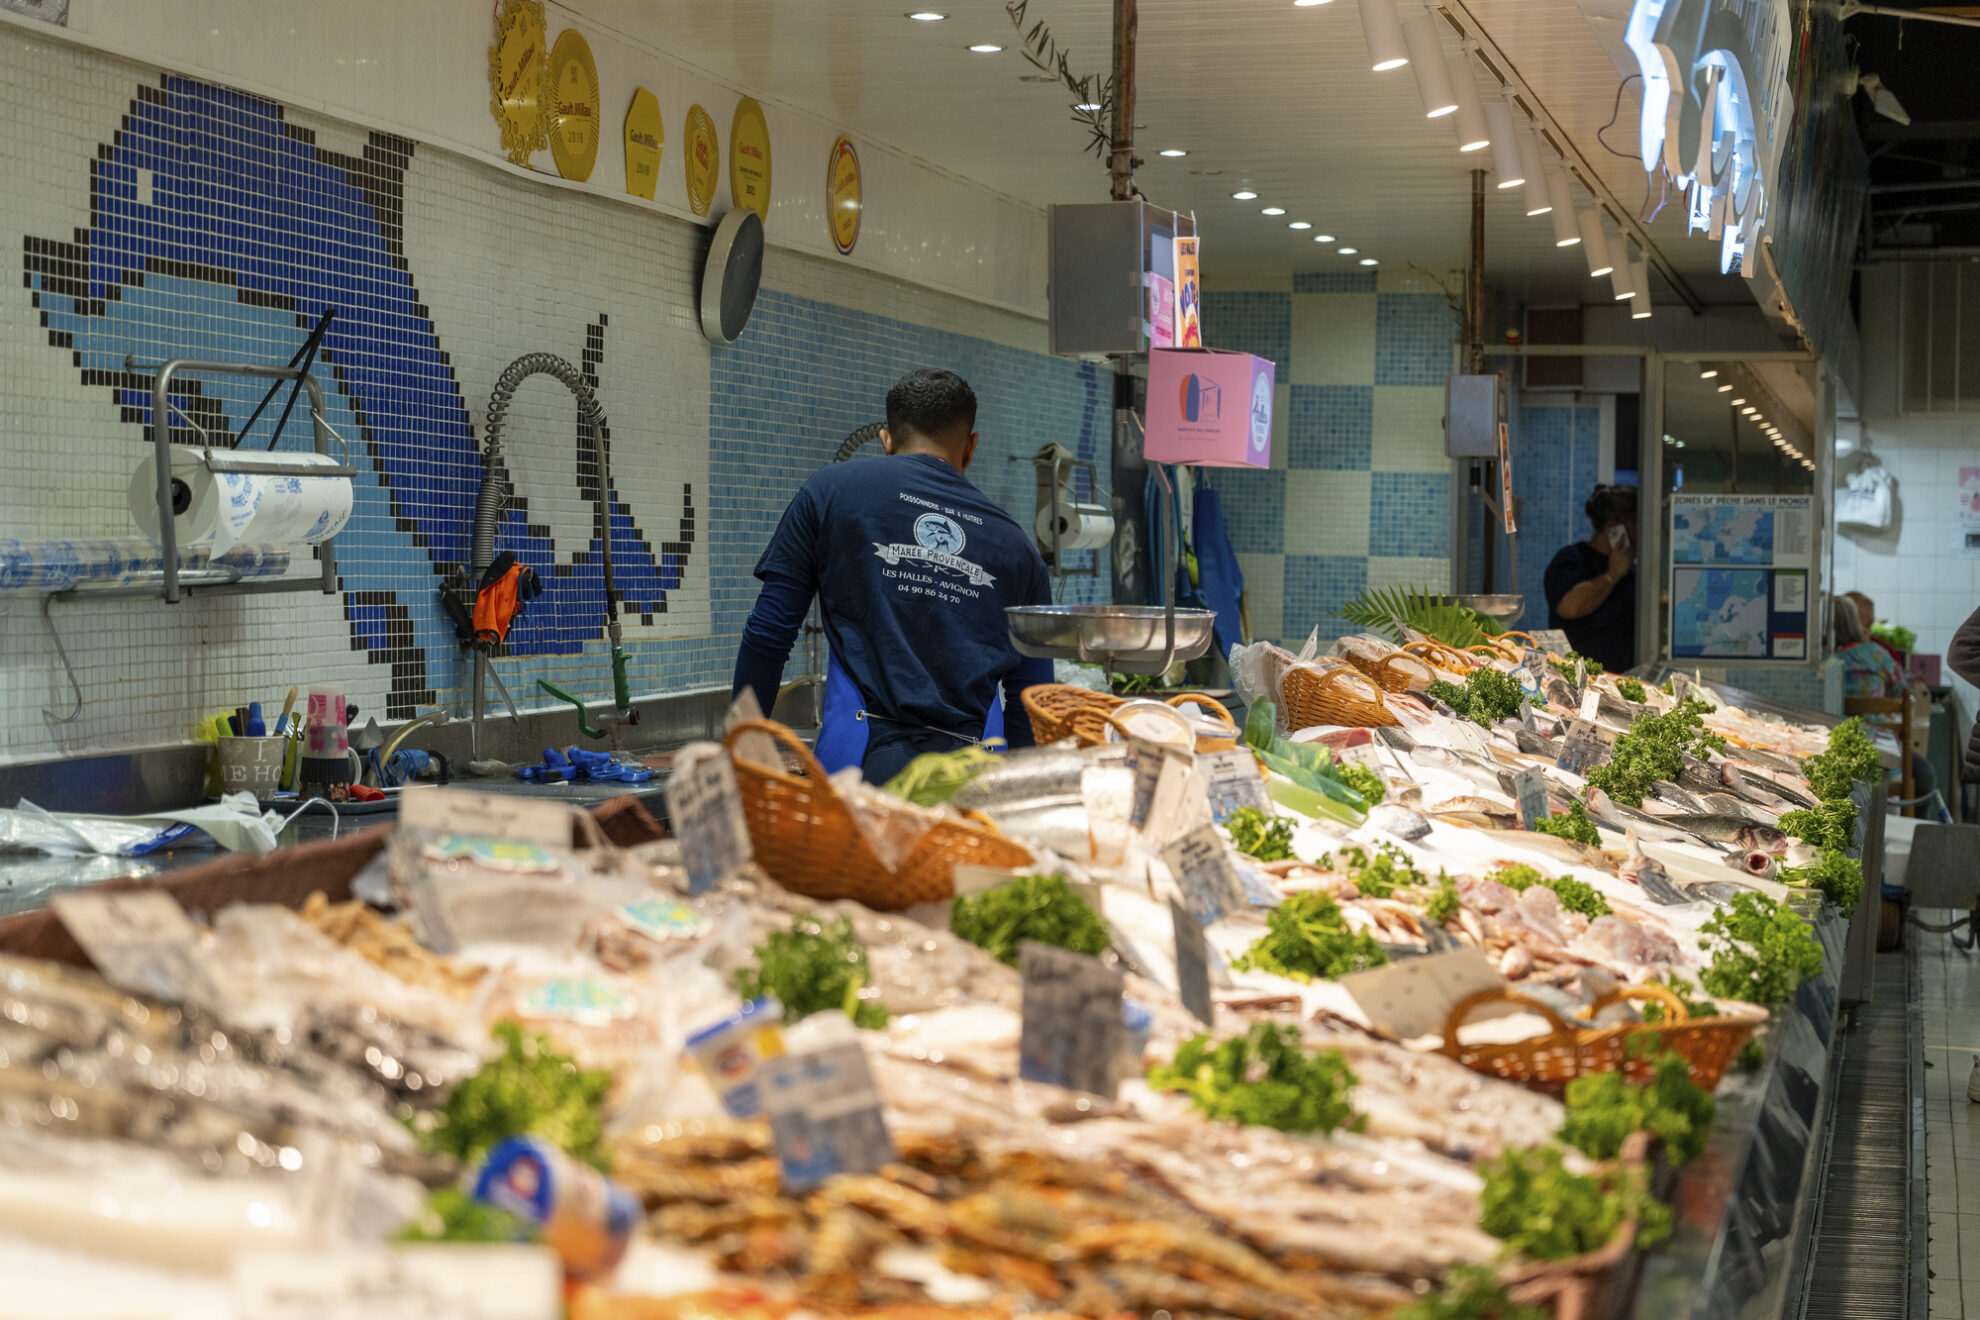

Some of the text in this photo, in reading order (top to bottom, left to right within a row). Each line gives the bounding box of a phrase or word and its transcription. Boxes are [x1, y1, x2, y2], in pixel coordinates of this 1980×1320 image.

[568, 131, 584, 144] 2018
[899, 492, 940, 511] POISSONNERIE
[1674, 497, 1701, 505] ZONES
[1743, 497, 1766, 505] DANS
[1768, 497, 1776, 505] LE
[1779, 497, 1810, 506] MONDE
[882, 568, 897, 578] LES
[899, 571, 933, 584] HALLES
[939, 581, 980, 598] AVIGNON
[897, 584, 909, 592] 04
[911, 586, 923, 594] 90
[924, 588, 936, 596] 86
[938, 591, 948, 601] 24
